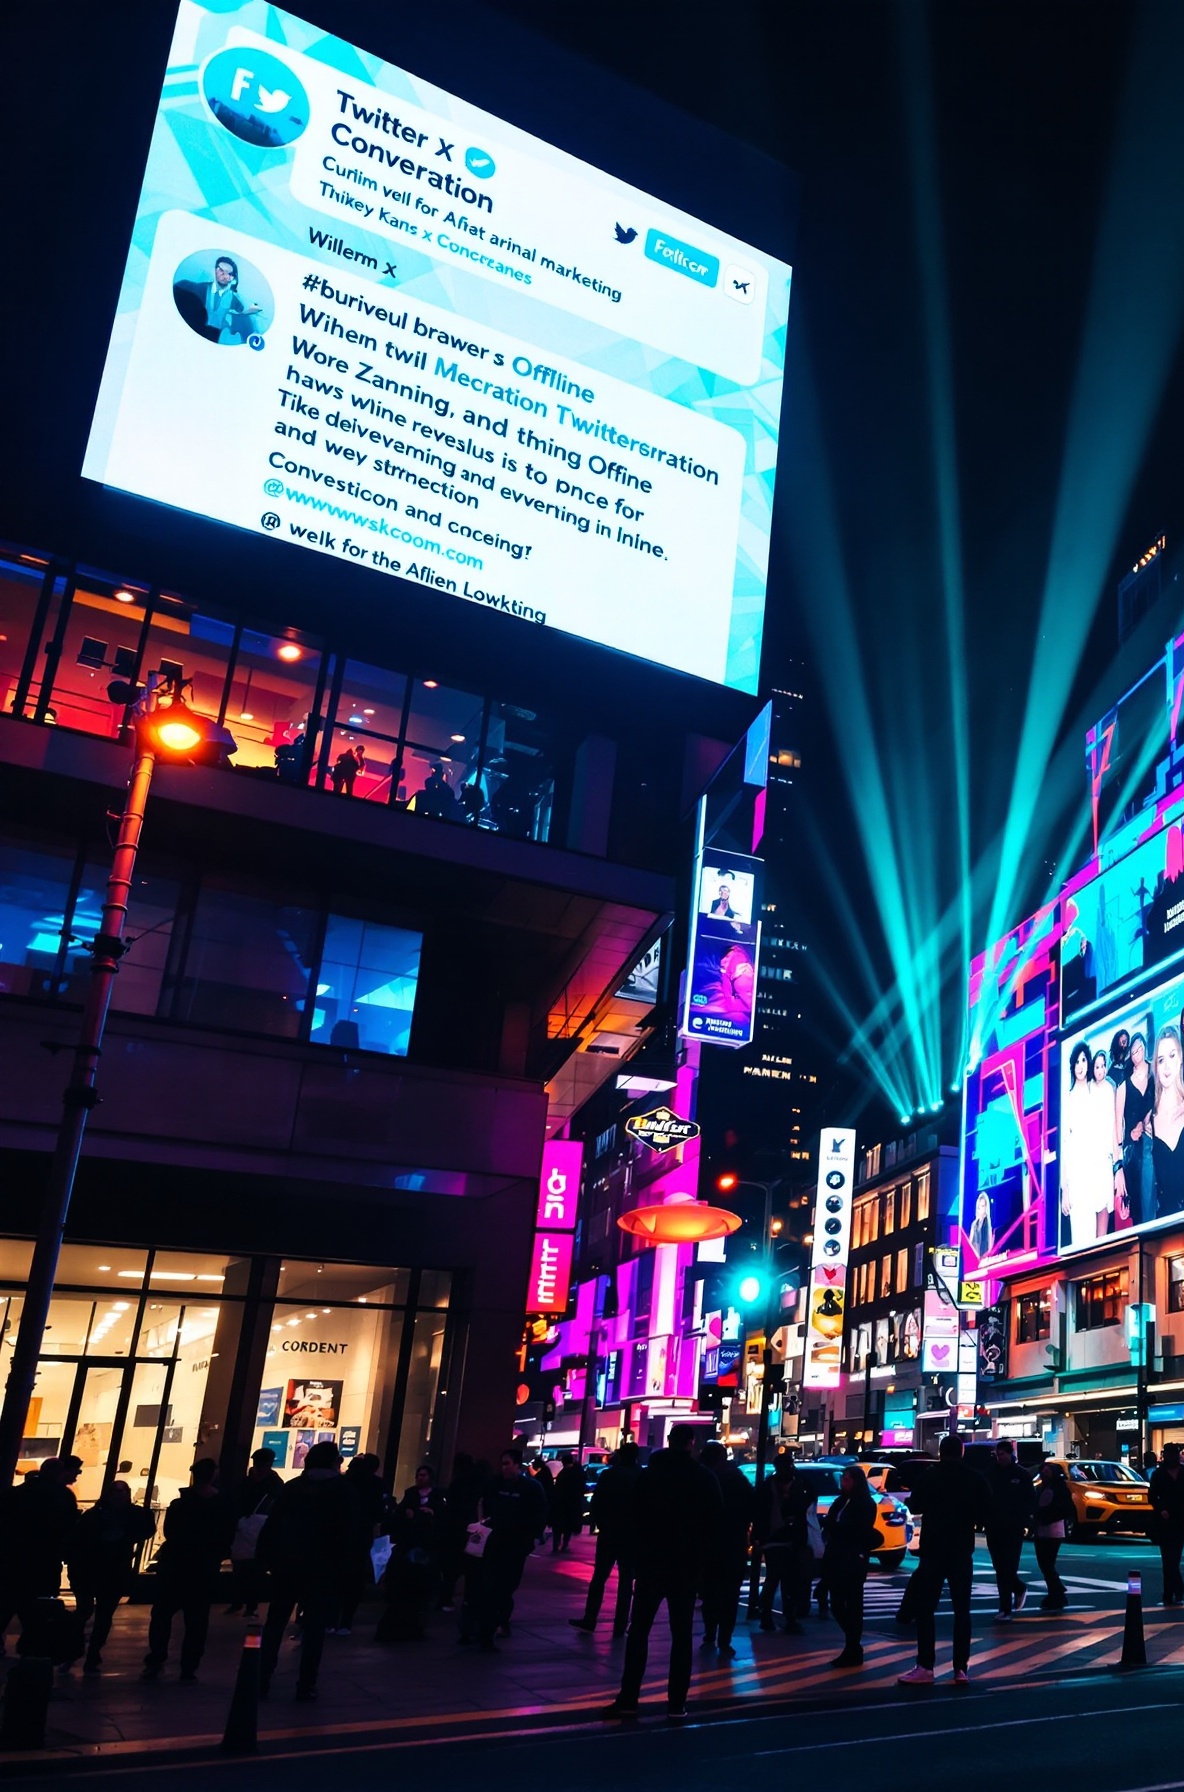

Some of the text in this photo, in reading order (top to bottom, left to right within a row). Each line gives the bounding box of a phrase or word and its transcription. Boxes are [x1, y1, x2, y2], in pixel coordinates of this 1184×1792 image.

[331, 122, 494, 213] Converation
[337, 89, 455, 162] Twitter X
[379, 207, 418, 236] Kans
[416, 197, 439, 218] for
[490, 232, 536, 263] arinal
[540, 257, 622, 303] marketing
[293, 337, 349, 374] Wore
[355, 361, 455, 419] Zanning,
[462, 410, 508, 438] and
[434, 357, 548, 418] Mecration
[274, 421, 317, 448] and
[325, 439, 368, 467] wey
[278, 388, 320, 420] Tike
[461, 469, 496, 491] and
[596, 519, 612, 539] in
[286, 365, 344, 400] haws
[501, 452, 517, 473] is
[525, 463, 548, 485] to
[615, 498, 645, 522] for
[268, 451, 399, 511] Convesticon
[405, 504, 442, 528] and
[289, 522, 336, 550] welk
[342, 538, 368, 559] for
[372, 551, 402, 571] the
[463, 581, 547, 625] Lowkting
[282, 1340, 348, 1354] CORDENT
